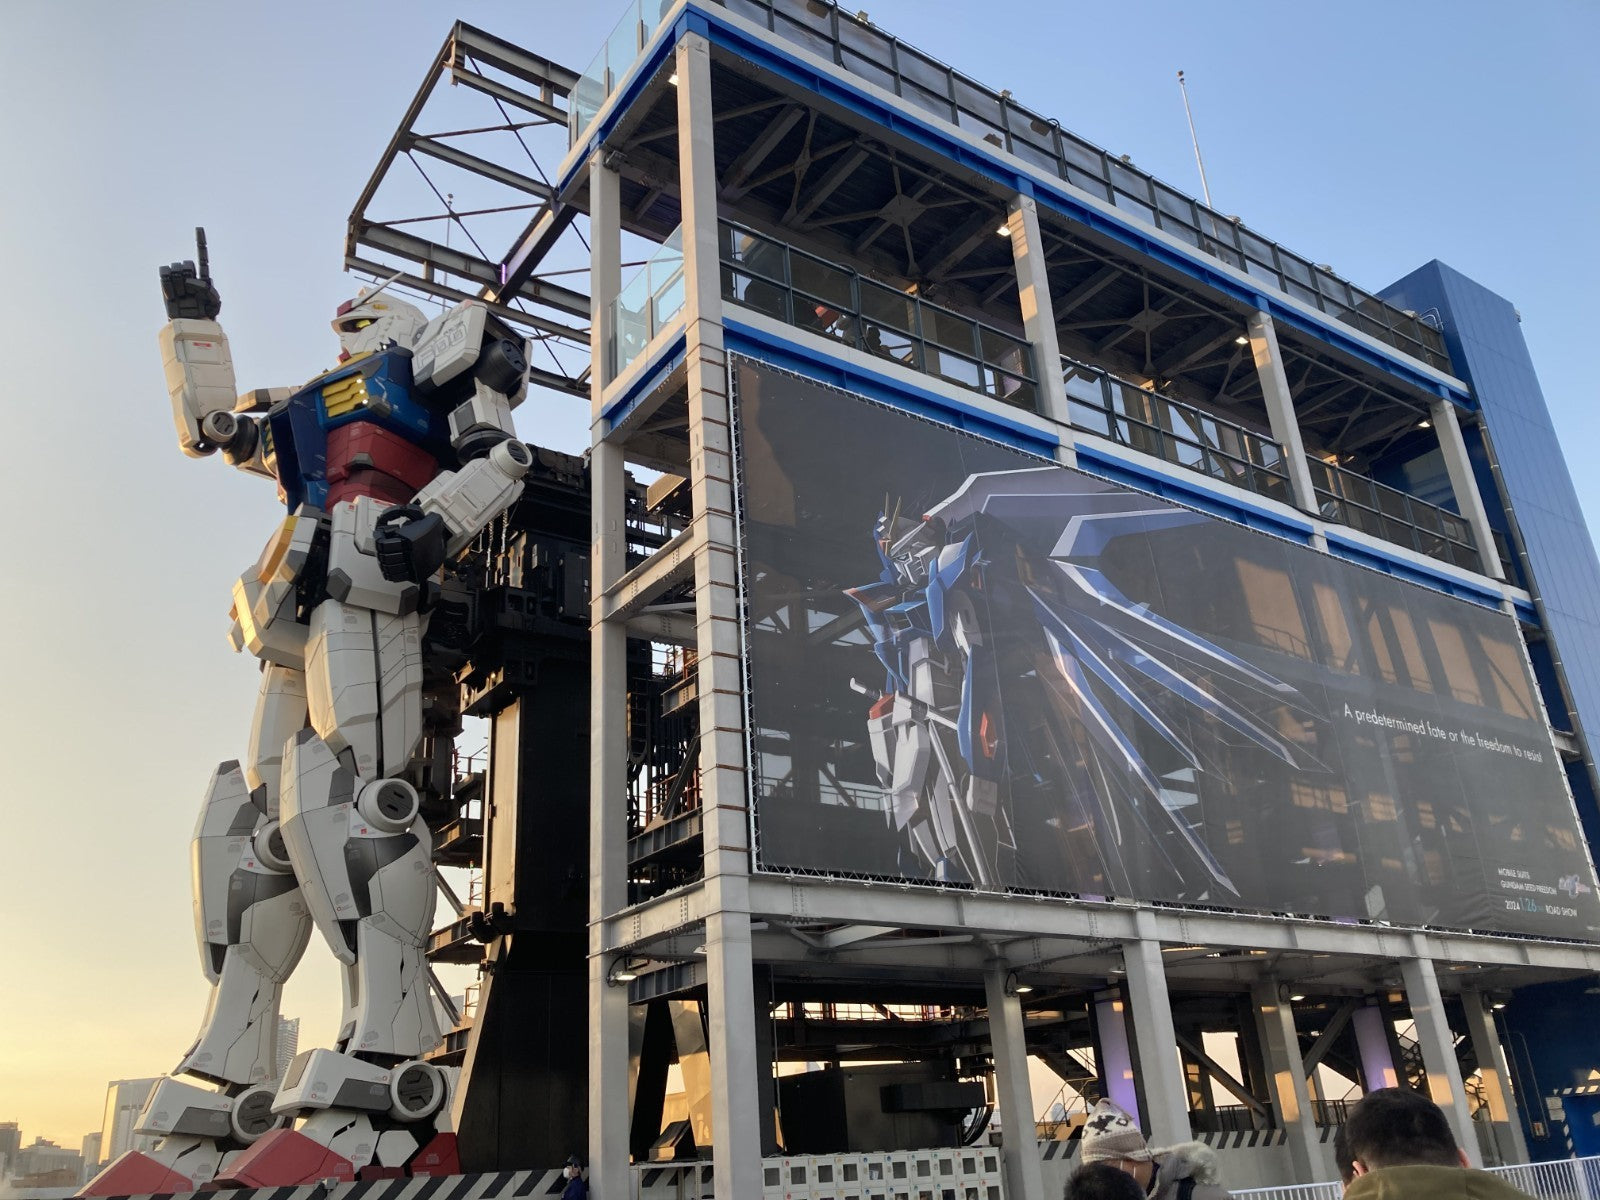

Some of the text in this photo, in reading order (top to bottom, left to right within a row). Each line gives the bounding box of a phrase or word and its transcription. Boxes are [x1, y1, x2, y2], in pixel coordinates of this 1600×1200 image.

[1344, 702, 1543, 763] A predetermined fate or the freedom to resist
[1498, 868, 1517, 878] MOBILE
[1500, 880, 1557, 895] GUNDAM SEED FREEDOM
[1505, 900, 1520, 910] 2024
[1545, 905, 1562, 915] ROAD
[1562, 907, 1578, 917] SHOW
